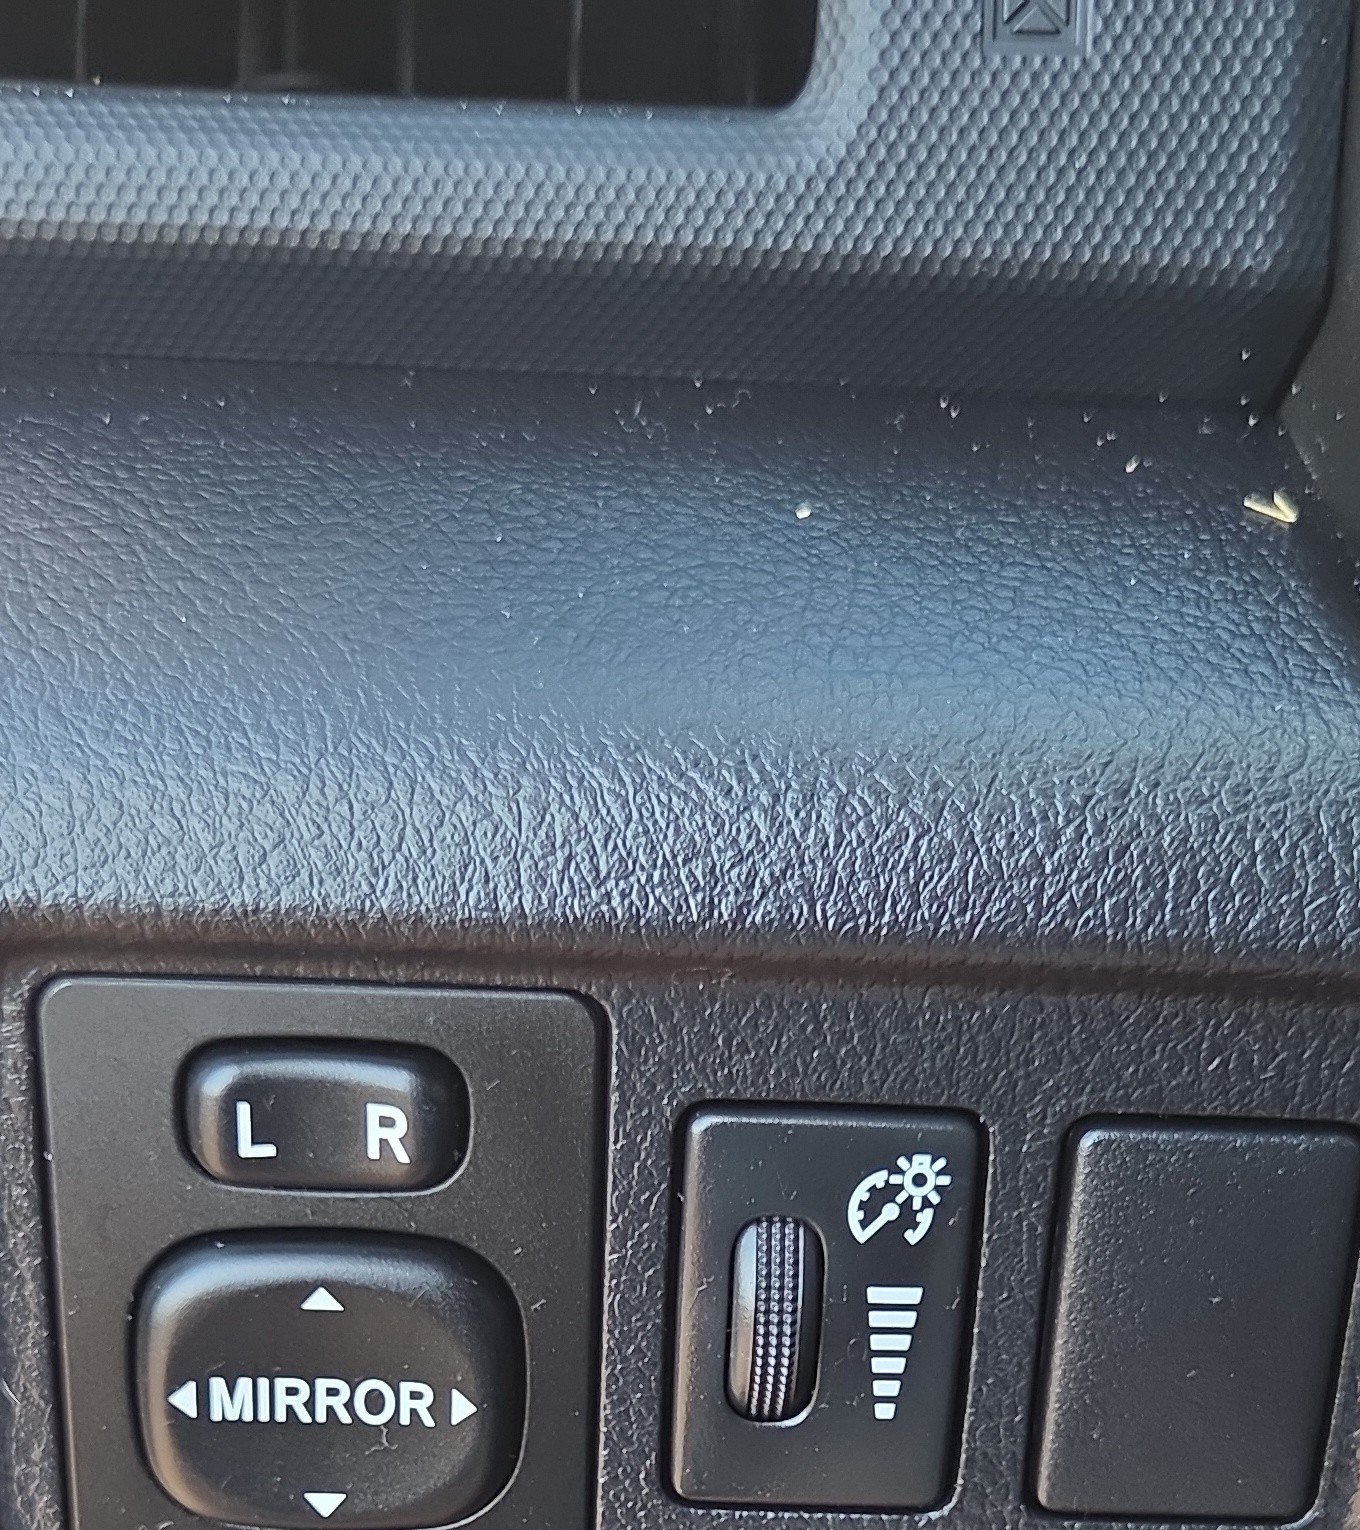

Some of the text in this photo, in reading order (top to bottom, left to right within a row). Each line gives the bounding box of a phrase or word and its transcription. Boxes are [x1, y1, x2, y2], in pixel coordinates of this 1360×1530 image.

[236, 1101, 411, 1163] L R
[209, 1376, 435, 1428] MIRROR
